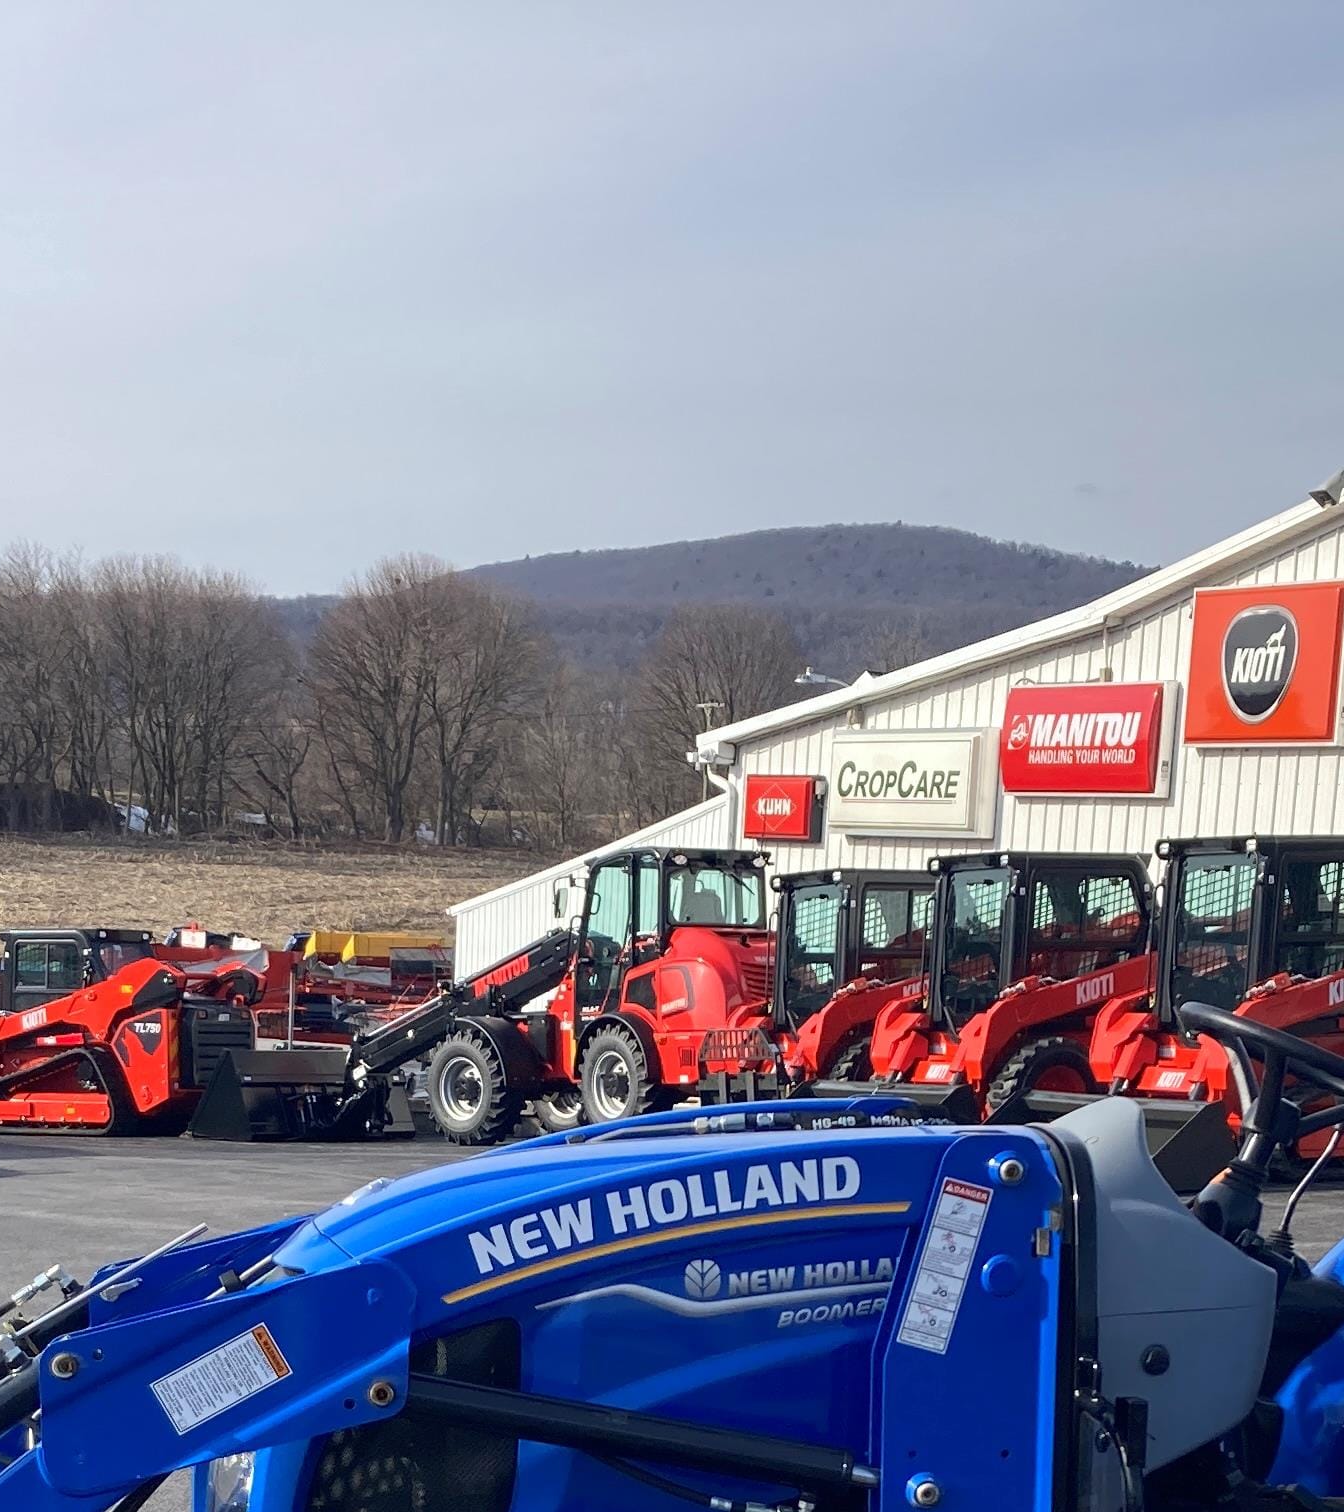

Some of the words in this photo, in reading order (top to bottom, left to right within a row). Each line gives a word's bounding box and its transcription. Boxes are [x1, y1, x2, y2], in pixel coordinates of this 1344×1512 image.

[1231, 645, 1286, 683] KIOTI
[1030, 712, 1142, 747] MANITOU
[1028, 749, 1073, 765] HANDLING
[1075, 748, 1100, 763] YOUR
[1101, 748, 1136, 764] WORLD
[757, 798, 792, 816] KUHN
[1076, 972, 1114, 1004] KIOTI
[21, 1008, 47, 1029] KIOTI
[134, 1023, 161, 1033] TL750
[1156, 1071, 1186, 1088] KIOTI
[468, 1198, 594, 1274] NEW
[606, 1156, 861, 1235] HOLLAND
[729, 1266, 795, 1296] NEW
[804, 1257, 899, 1287] HOLLA
